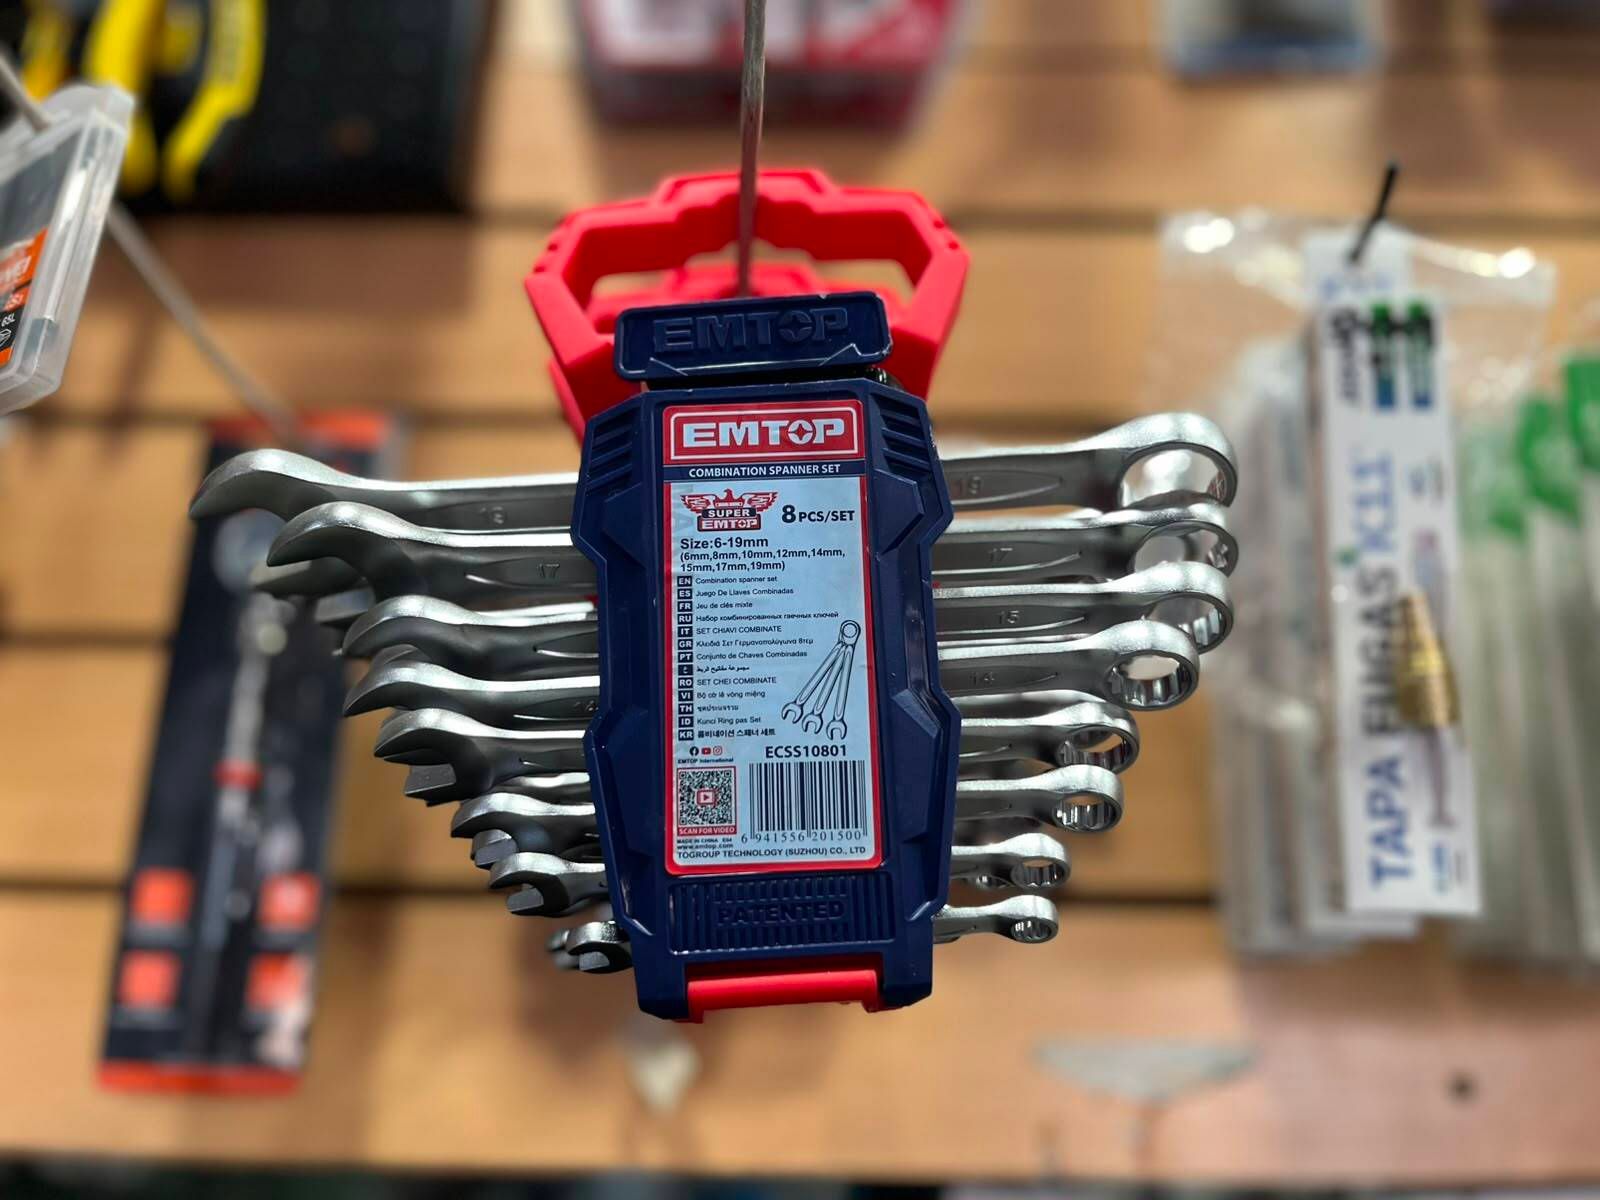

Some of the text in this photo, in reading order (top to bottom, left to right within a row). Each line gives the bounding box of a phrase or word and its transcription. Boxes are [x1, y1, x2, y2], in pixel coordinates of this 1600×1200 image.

[653, 307, 849, 352] EMTOP
[682, 418, 845, 448] EMTOP
[689, 464, 841, 478] COMBINATION SPANNER SET
[708, 509, 750, 518] SUPER
[781, 504, 855, 523] 8 PCS/SET
[702, 519, 758, 530] EMTOP
[680, 537, 769, 549] Size:6-19mm
[680, 548, 846, 561] (6mm,8mm,10mm,12mm,14mm,
[988, 547, 1013, 563] 17
[536, 563, 561, 580] 17
[680, 560, 785, 572] 15mm,17mm,19mm)
[679, 577, 691, 585] EN
[695, 577, 738, 585] Combination
[695, 590, 717, 598] Juego
[729, 588, 751, 596] Llaves
[752, 587, 794, 595] Combinadas
[679, 615, 692, 623] RU
[695, 615, 719, 623] Набор
[1000, 610, 1021, 625] 15
[738, 625, 782, 633] COMBINATE
[679, 640, 692, 648] GR
[696, 653, 727, 661] Conjunto
[738, 651, 764, 659] Chaves
[732, 677, 777, 685] COMBINATE
[680, 705, 693, 713] TH
[681, 718, 692, 726] ID
[697, 717, 716, 725] Kunci
[717, 717, 734, 725] Ring
[679, 730, 693, 738] KR
[765, 744, 847, 758] ECSS10801
[1365, 753, 1411, 891] TAPA
[741, 830, 861, 843] 6 941556 201500
[678, 850, 721, 859] TOGROUP
[723, 848, 784, 858] TECHNOLOGY
[785, 847, 827, 857] (SUZHOU)
[850, 846, 867, 854] LTD
[717, 900, 846, 926] PATENTED
